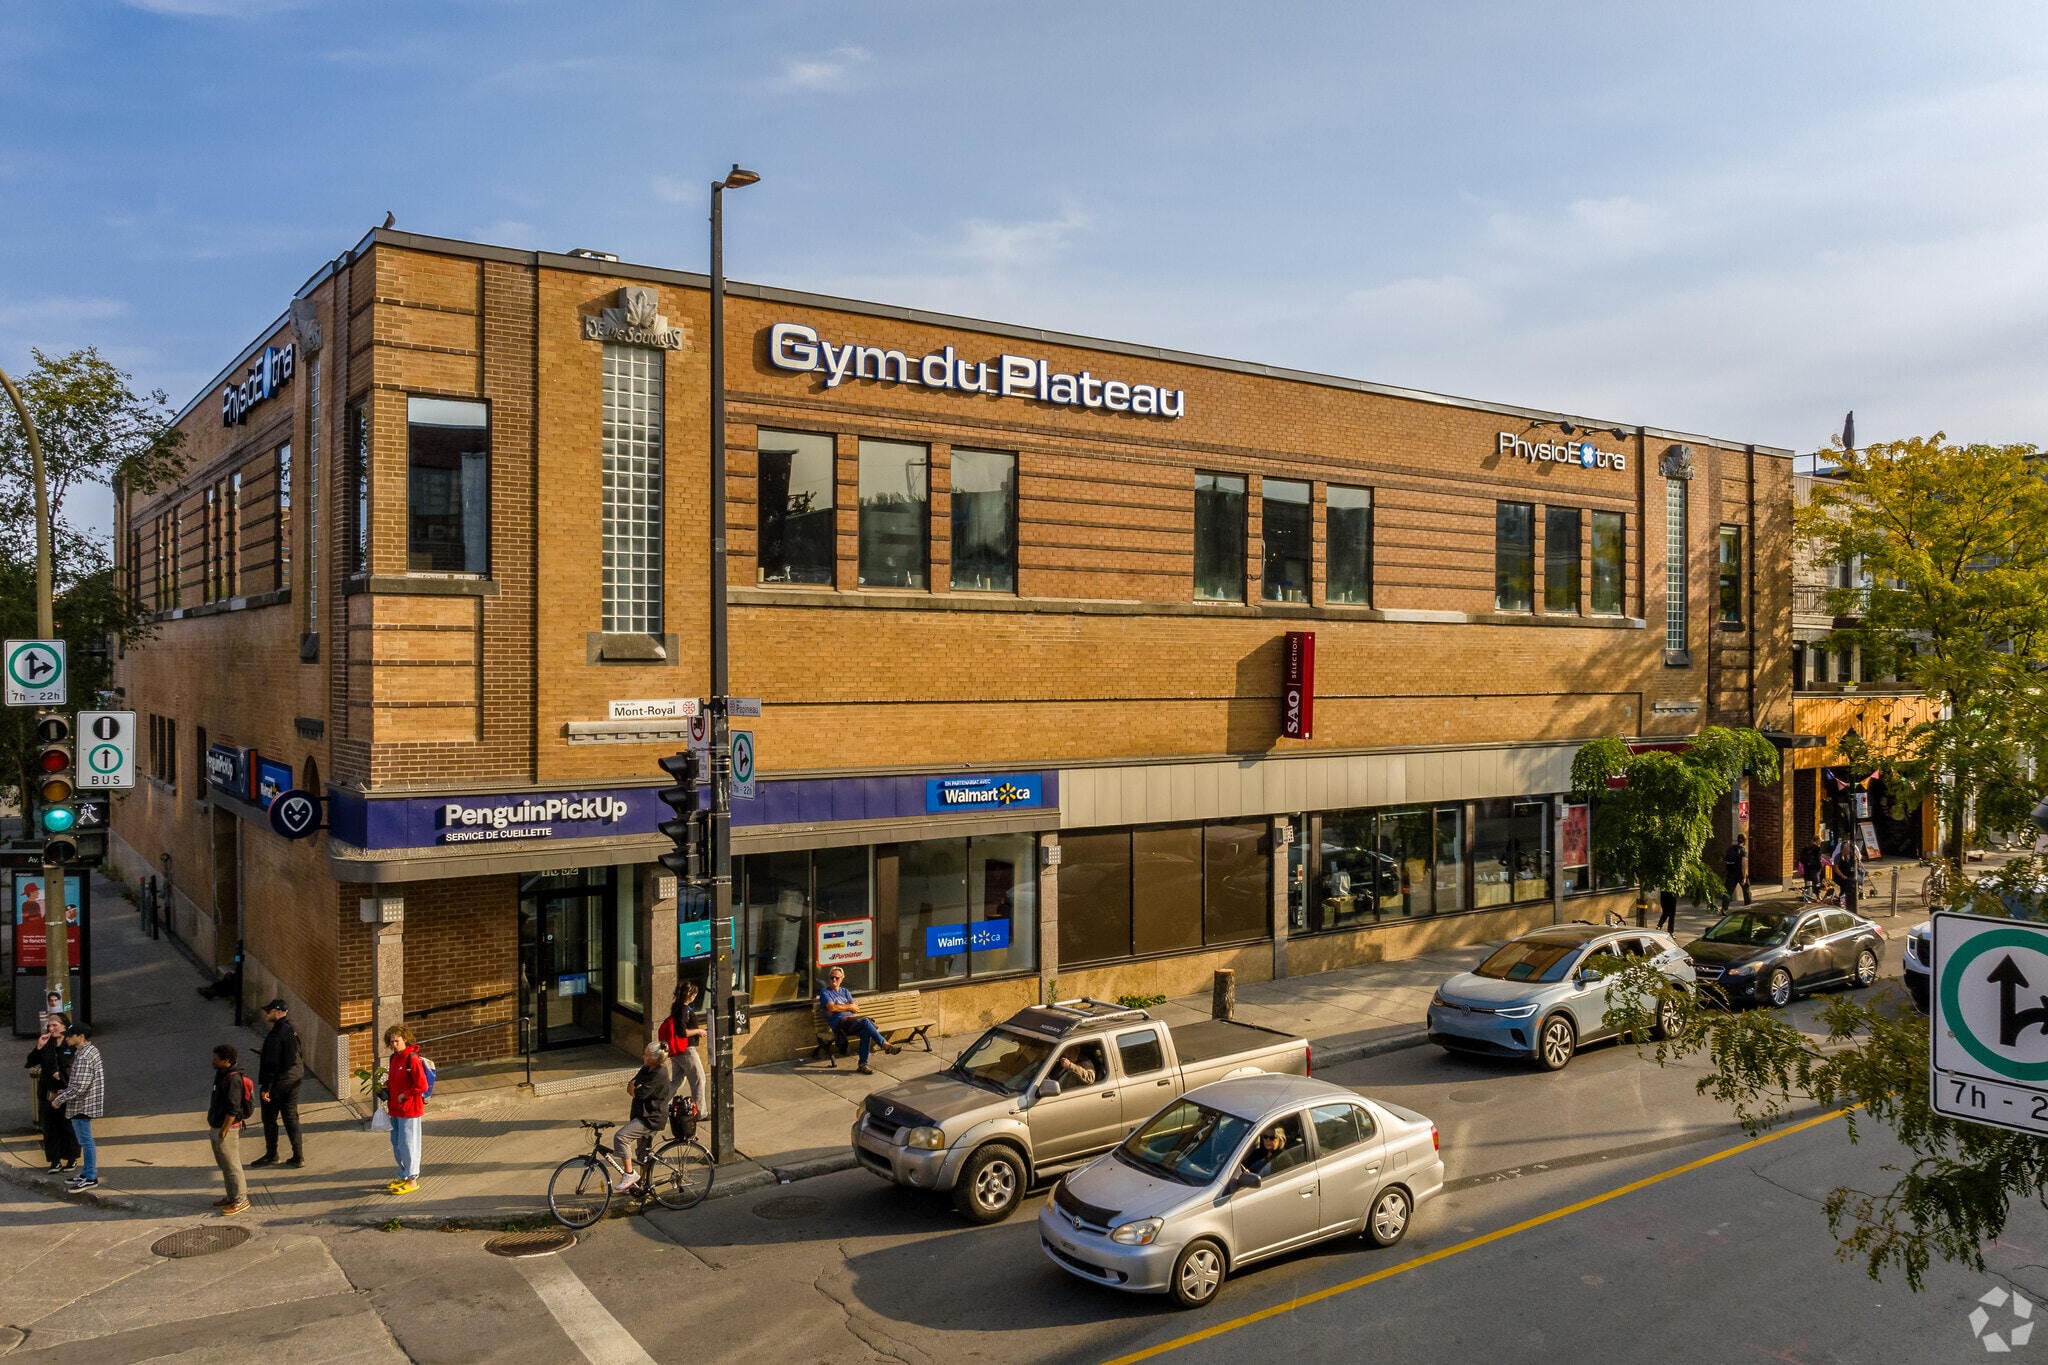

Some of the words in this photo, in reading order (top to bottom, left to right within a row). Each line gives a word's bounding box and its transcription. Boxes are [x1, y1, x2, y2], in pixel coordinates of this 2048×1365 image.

[770, 322, 907, 388] Gym
[920, 346, 988, 393] du
[999, 354, 1186, 418] Plateau
[12, 692, 26, 701] 7h
[39, 692, 60, 701] 22h
[614, 705, 676, 717] Mont-Royal
[1287, 690, 1300, 734] SAQ
[91, 775, 120, 785] BUS
[945, 788, 999, 803] Walmart
[445, 796, 628, 829] PenguinPickUp
[446, 832, 484, 842] SERVICE
[486, 831, 499, 839] DE
[500, 828, 552, 839] CUEILLETTE
[1950, 1079, 1986, 1109] 7h
